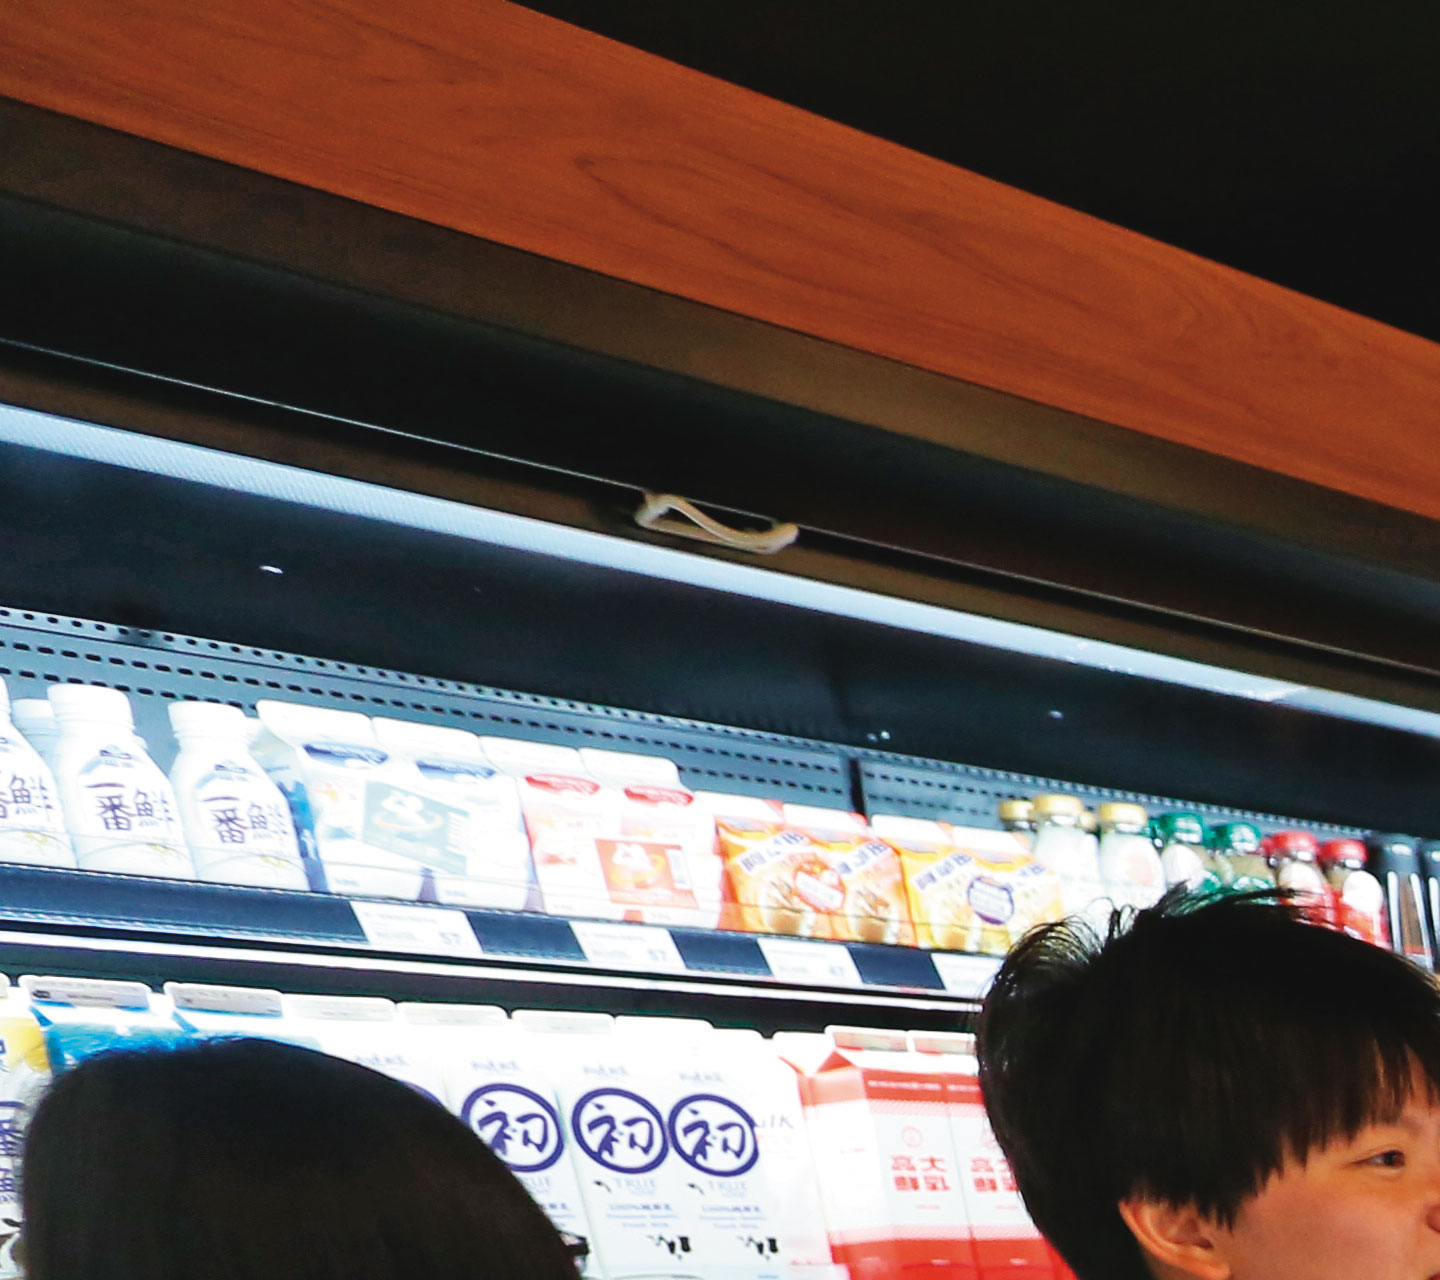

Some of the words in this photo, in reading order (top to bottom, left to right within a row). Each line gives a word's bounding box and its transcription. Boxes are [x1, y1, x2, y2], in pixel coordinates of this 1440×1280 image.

[475, 1100, 548, 1160] 初
[587, 1101, 655, 1159] 初
[680, 1108, 749, 1167] 初
